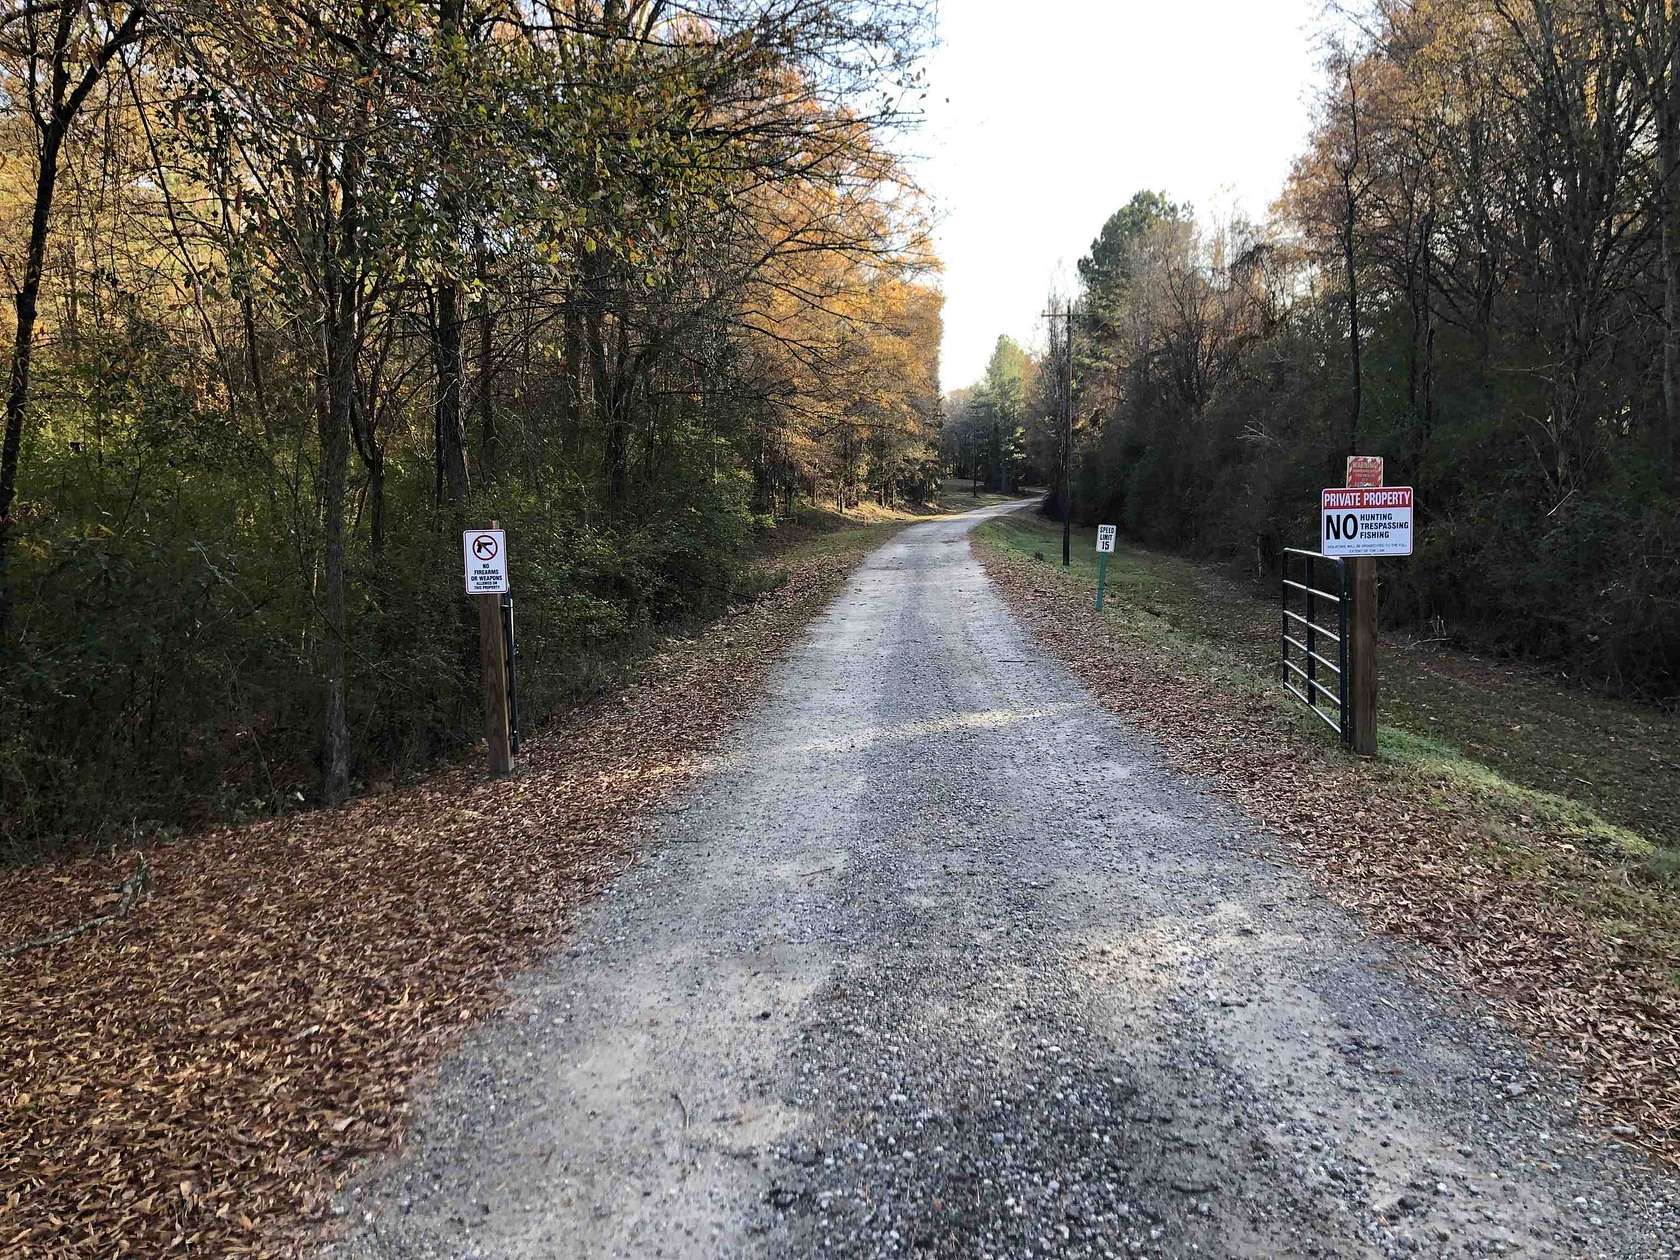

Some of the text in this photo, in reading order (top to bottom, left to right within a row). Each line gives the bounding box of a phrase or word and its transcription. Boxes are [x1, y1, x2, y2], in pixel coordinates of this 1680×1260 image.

[1324, 491, 1410, 507] PRIVATE PROPERTY
[1360, 512, 1393, 521] HUNTING
[1099, 526, 1115, 534] SPEED
[1326, 513, 1358, 540] NO
[1360, 521, 1409, 530] TRESPASSING
[1360, 530, 1390, 539] FISHING
[1102, 541, 1110, 550] 15
